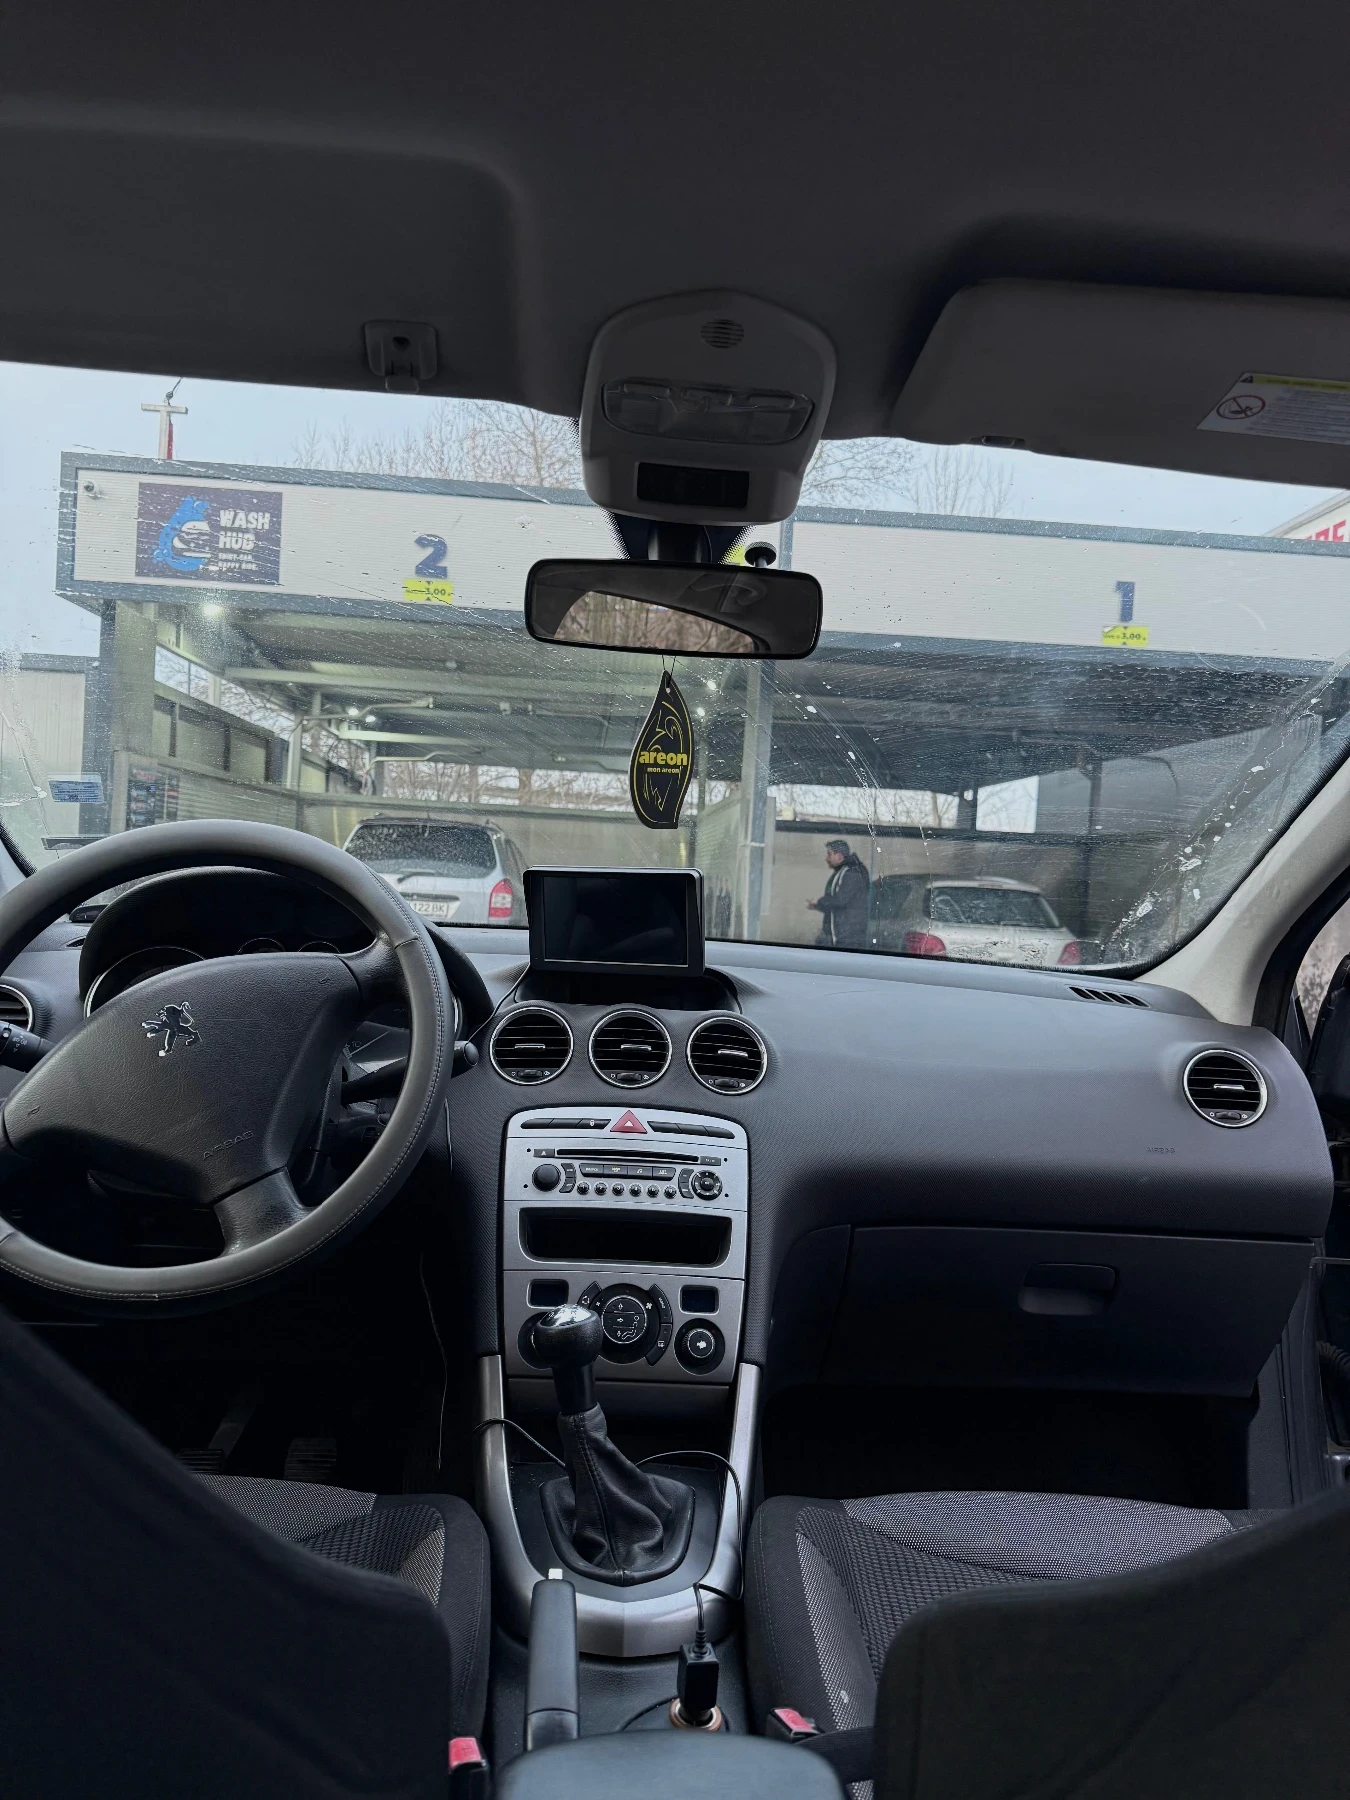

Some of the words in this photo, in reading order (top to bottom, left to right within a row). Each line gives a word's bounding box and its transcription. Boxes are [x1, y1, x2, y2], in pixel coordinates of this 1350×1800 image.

[219, 508, 271, 530] WASH
[219, 531, 256, 550] HUB
[414, 534, 448, 579] 2
[1115, 581, 1136, 622] 1
[639, 751, 688, 766] areon
